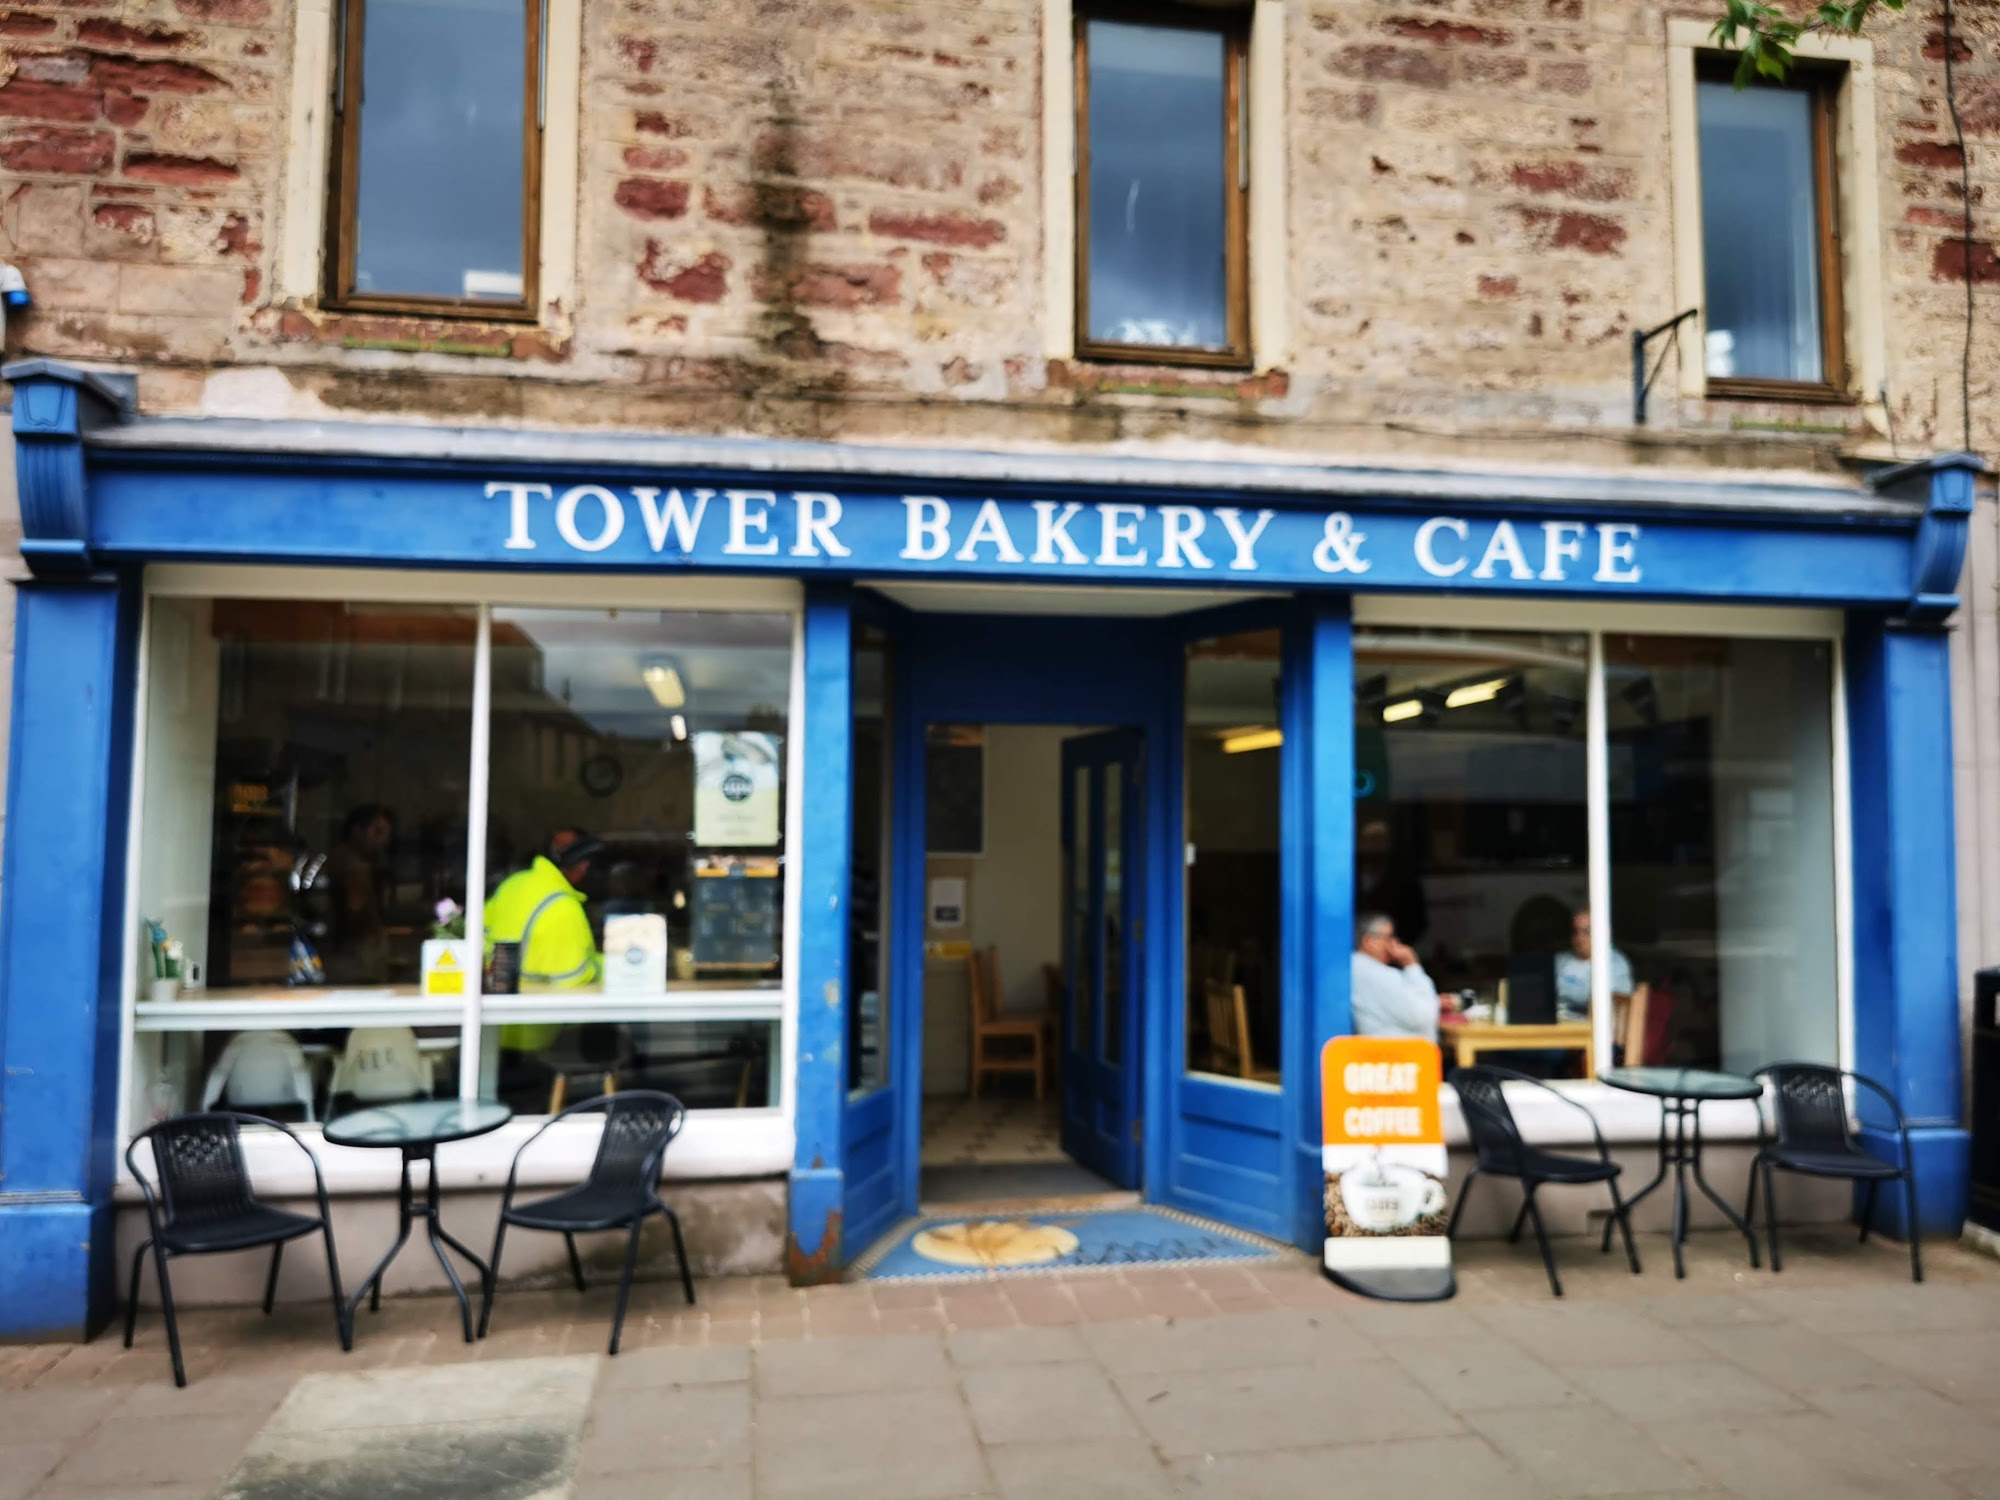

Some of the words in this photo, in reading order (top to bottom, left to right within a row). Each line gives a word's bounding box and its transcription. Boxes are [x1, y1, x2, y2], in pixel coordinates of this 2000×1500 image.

[484, 481, 852, 558] TOWER
[899, 496, 1274, 571] BAKERY
[1312, 512, 1371, 575] &
[1413, 516, 1642, 584] CAFE
[1343, 1062, 1420, 1094] GREAT
[1343, 1106, 1422, 1137] COFFEE
